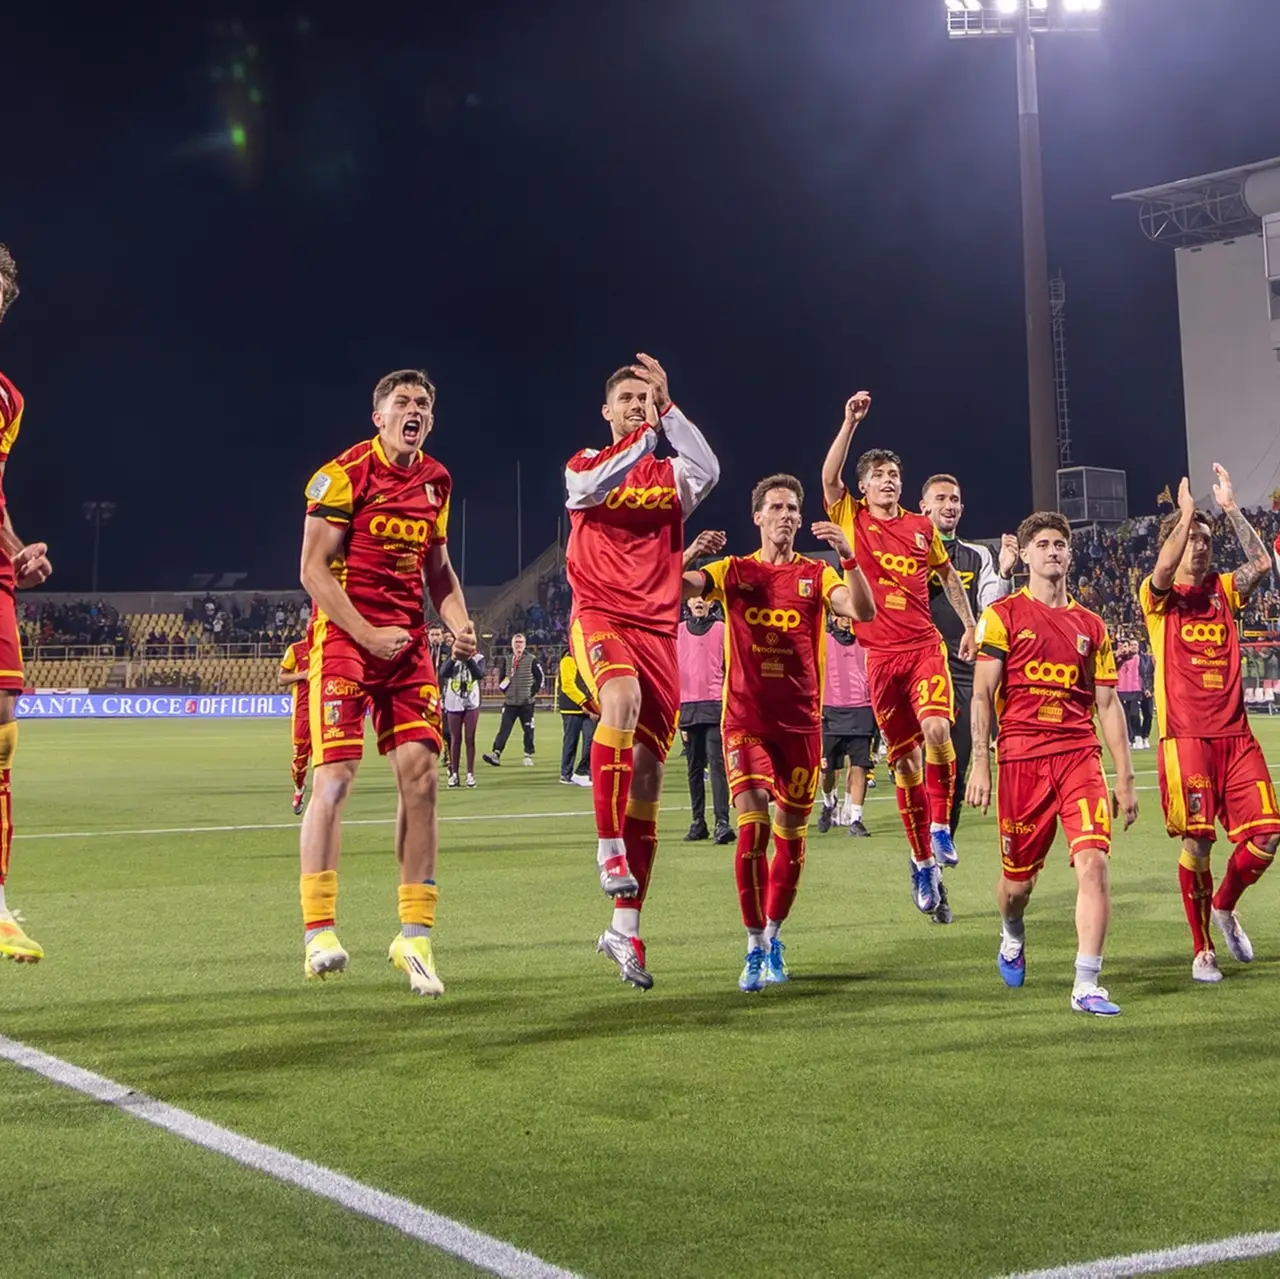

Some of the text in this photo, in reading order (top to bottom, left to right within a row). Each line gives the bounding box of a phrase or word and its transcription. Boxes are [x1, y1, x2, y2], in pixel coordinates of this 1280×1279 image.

[369, 515, 429, 542] coop
[744, 607, 801, 632] coop
[1181, 623, 1227, 646] coop
[1024, 660, 1080, 689] coop
[917, 674, 948, 706] 32
[17, 697, 96, 715] SANTA
[101, 696, 183, 715] CROCE
[199, 696, 277, 714] OFFICIAL
[788, 765, 819, 799] 84
[1077, 797, 1111, 832] 14
